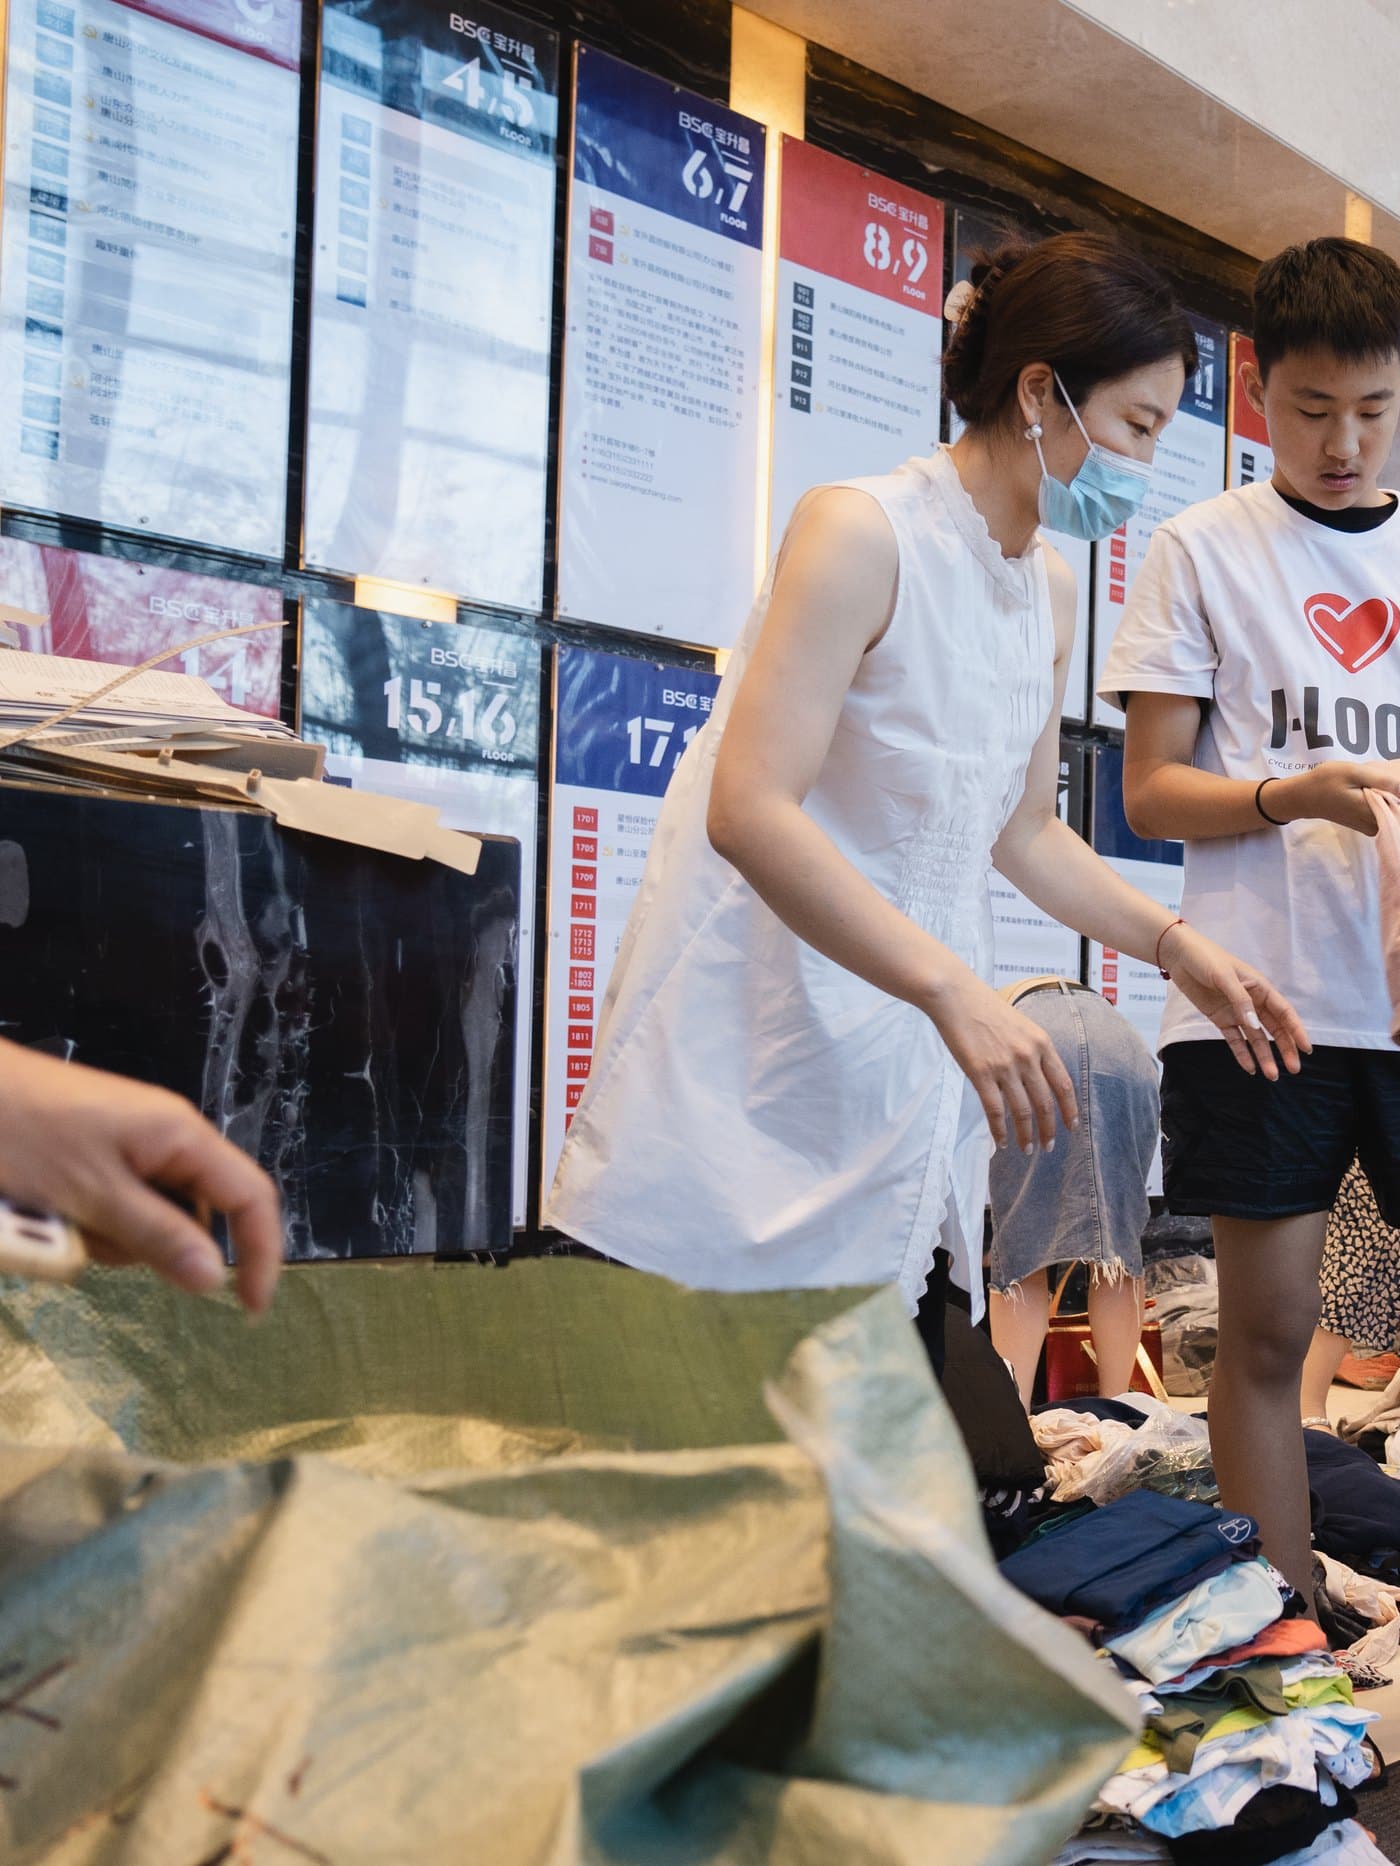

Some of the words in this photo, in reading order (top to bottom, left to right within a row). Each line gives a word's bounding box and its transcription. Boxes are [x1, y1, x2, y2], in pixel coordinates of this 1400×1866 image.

[493, 32, 535, 61] 宝升昌
[500, 126, 532, 147] FLOOR
[715, 128, 750, 155] 宝升昌
[720, 212, 747, 231] FLOOR
[898, 203, 929, 230] 宝升昌
[902, 284, 926, 301] FLOOR
[473, 653, 517, 679] 宝升昌
[482, 748, 515, 763] FLOOR
[1268, 758, 1293, 770] CYCLE
[576, 814, 595, 824] 1701
[575, 843, 595, 853] 1705
[575, 872, 594, 882] 1709
[574, 901, 593, 911] 1711
[573, 928, 593, 938] 1712
[573, 936, 593, 947] 1713
[573, 946, 593, 956] 1715
[574, 969, 593, 979] 1802
[572, 1002, 591, 1012] 1805
[571, 1032, 589, 1041] 1811
[570, 1062, 589, 1071] 1812
